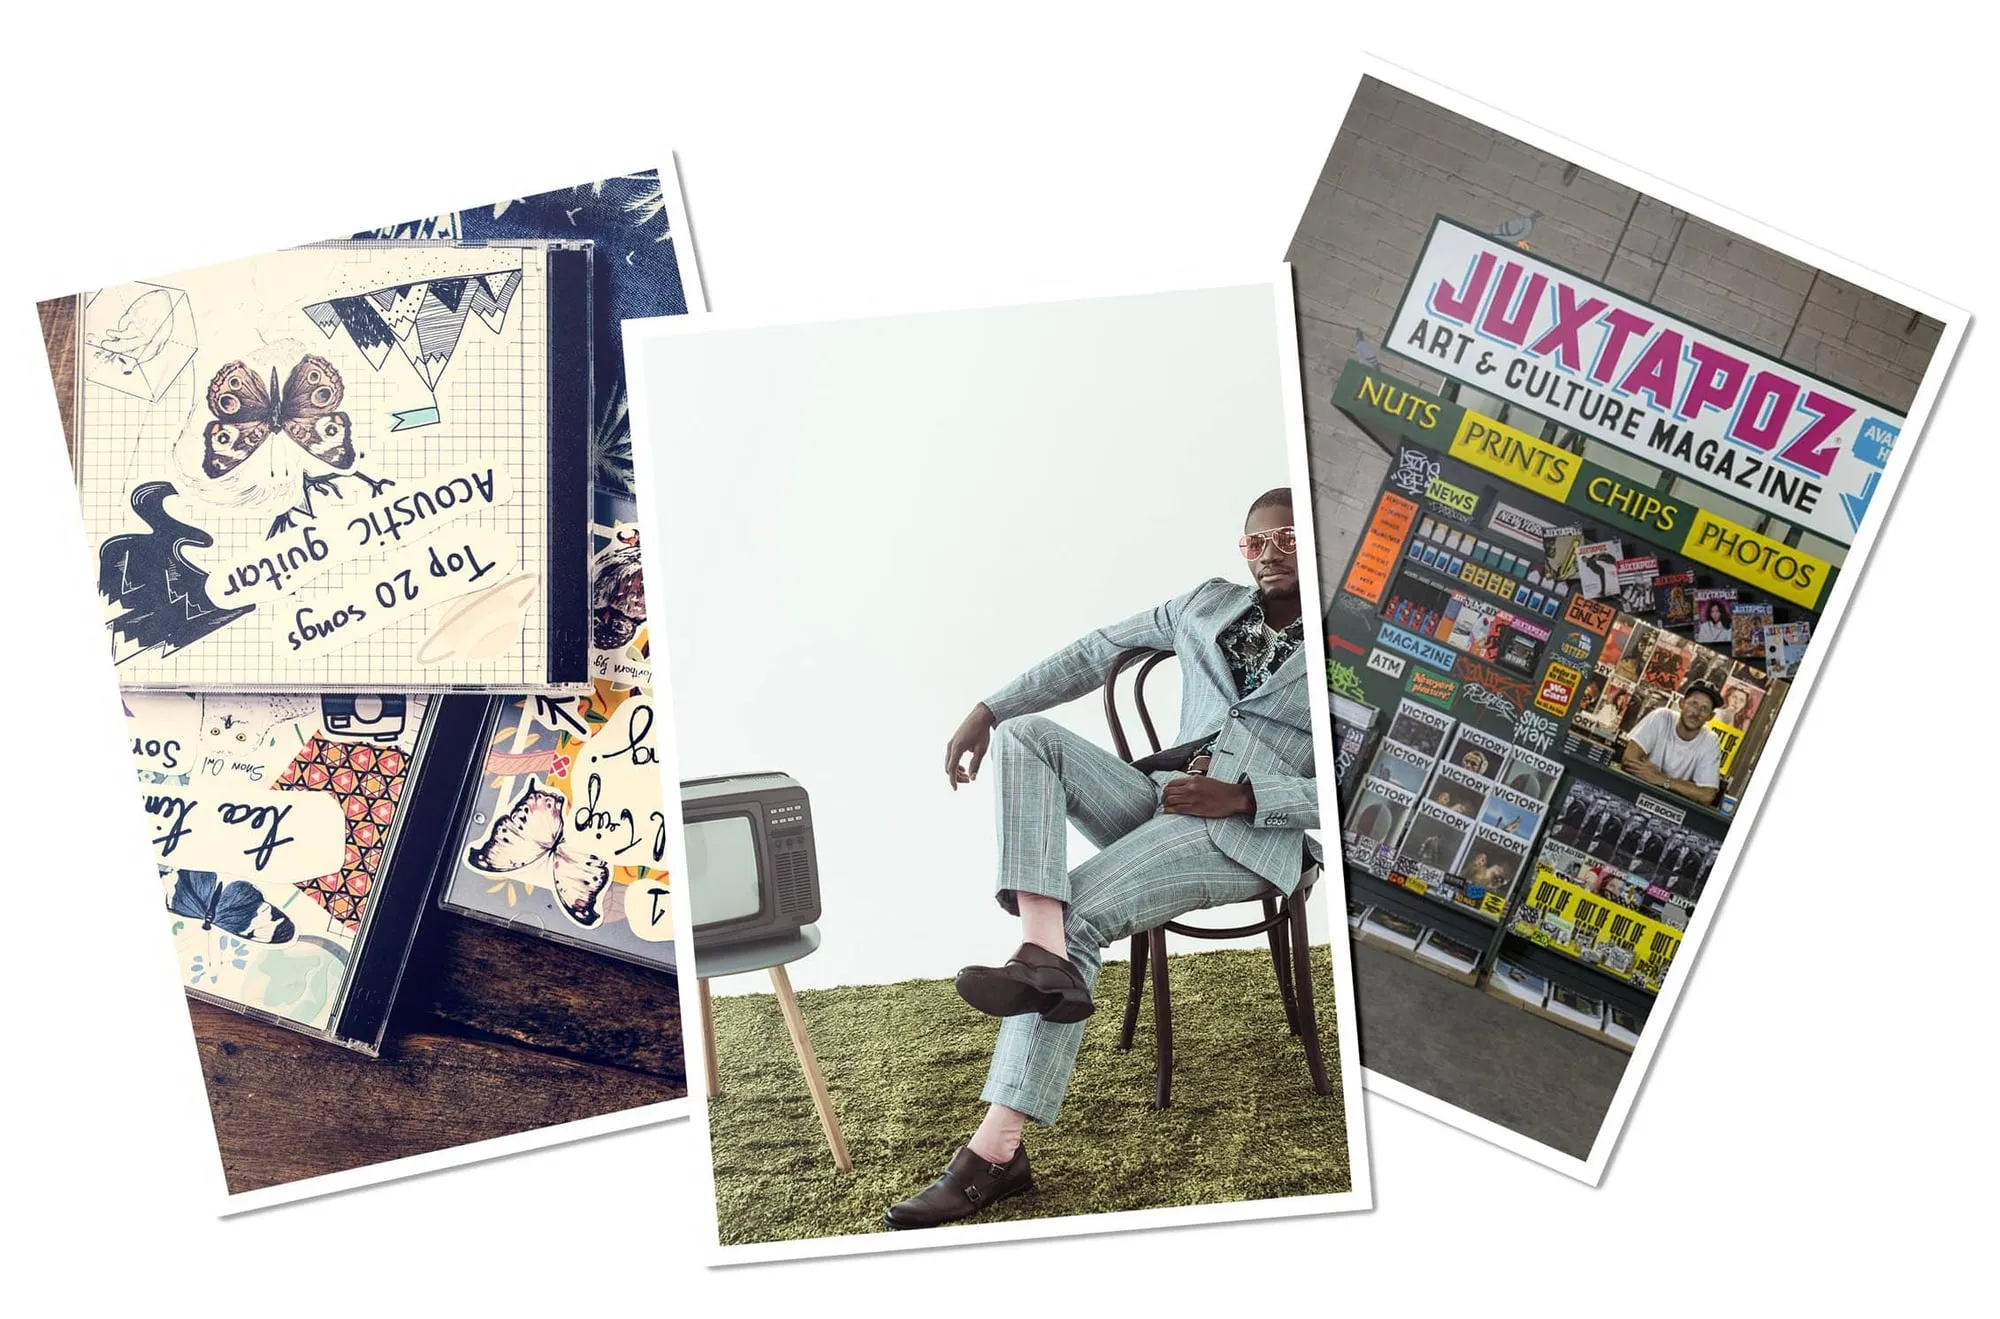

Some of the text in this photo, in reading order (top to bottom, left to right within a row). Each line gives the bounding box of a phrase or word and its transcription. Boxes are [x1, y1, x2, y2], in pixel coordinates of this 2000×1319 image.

[1429, 251, 1858, 476] JUXTAPOZ
[1407, 319, 1822, 514] ART & CULTURE MAGAZINE
[1358, 377, 1441, 428] NUTS
[1465, 424, 1568, 486] PRINTS
[1588, 476, 1678, 532] CHIPS
[1700, 523, 1814, 589] PHOTOS
[1429, 482, 1475, 511] NEWS
[224, 468, 495, 596] Acoustic guitar
[1619, 558, 1658, 571] JUXTAPOZ
[289, 545, 495, 652] Top 20 songs
[1574, 595, 1611, 618] CASH
[1381, 628, 1453, 667] MAGAZINE
[1371, 654, 1400, 674] ATM
[1543, 688, 1569, 704] Card
[1550, 683, 1567, 695] We
[1401, 703, 1449, 730] VICTORY
[1383, 741, 1432, 770] VICTORY
[1460, 728, 1508, 755] VICTORY
[202, 756, 265, 782] Snow Owl
[1514, 748, 1562, 776] VICTORY
[1364, 778, 1412, 805] VICTORY
[1441, 765, 1489, 793] VICTORY
[1494, 786, 1543, 813] VICTORY
[1638, 798, 1683, 823] ART BOOKS
[1421, 802, 1470, 830] VICTORY
[1479, 826, 1527, 853] VICTORY
[1536, 881, 1573, 911] OUT OF
[1576, 899, 1611, 928] OUT OF
[1611, 914, 1633, 936] OUT
[1630, 923, 1646, 944] OF
[1652, 931, 1675, 954] OUT
